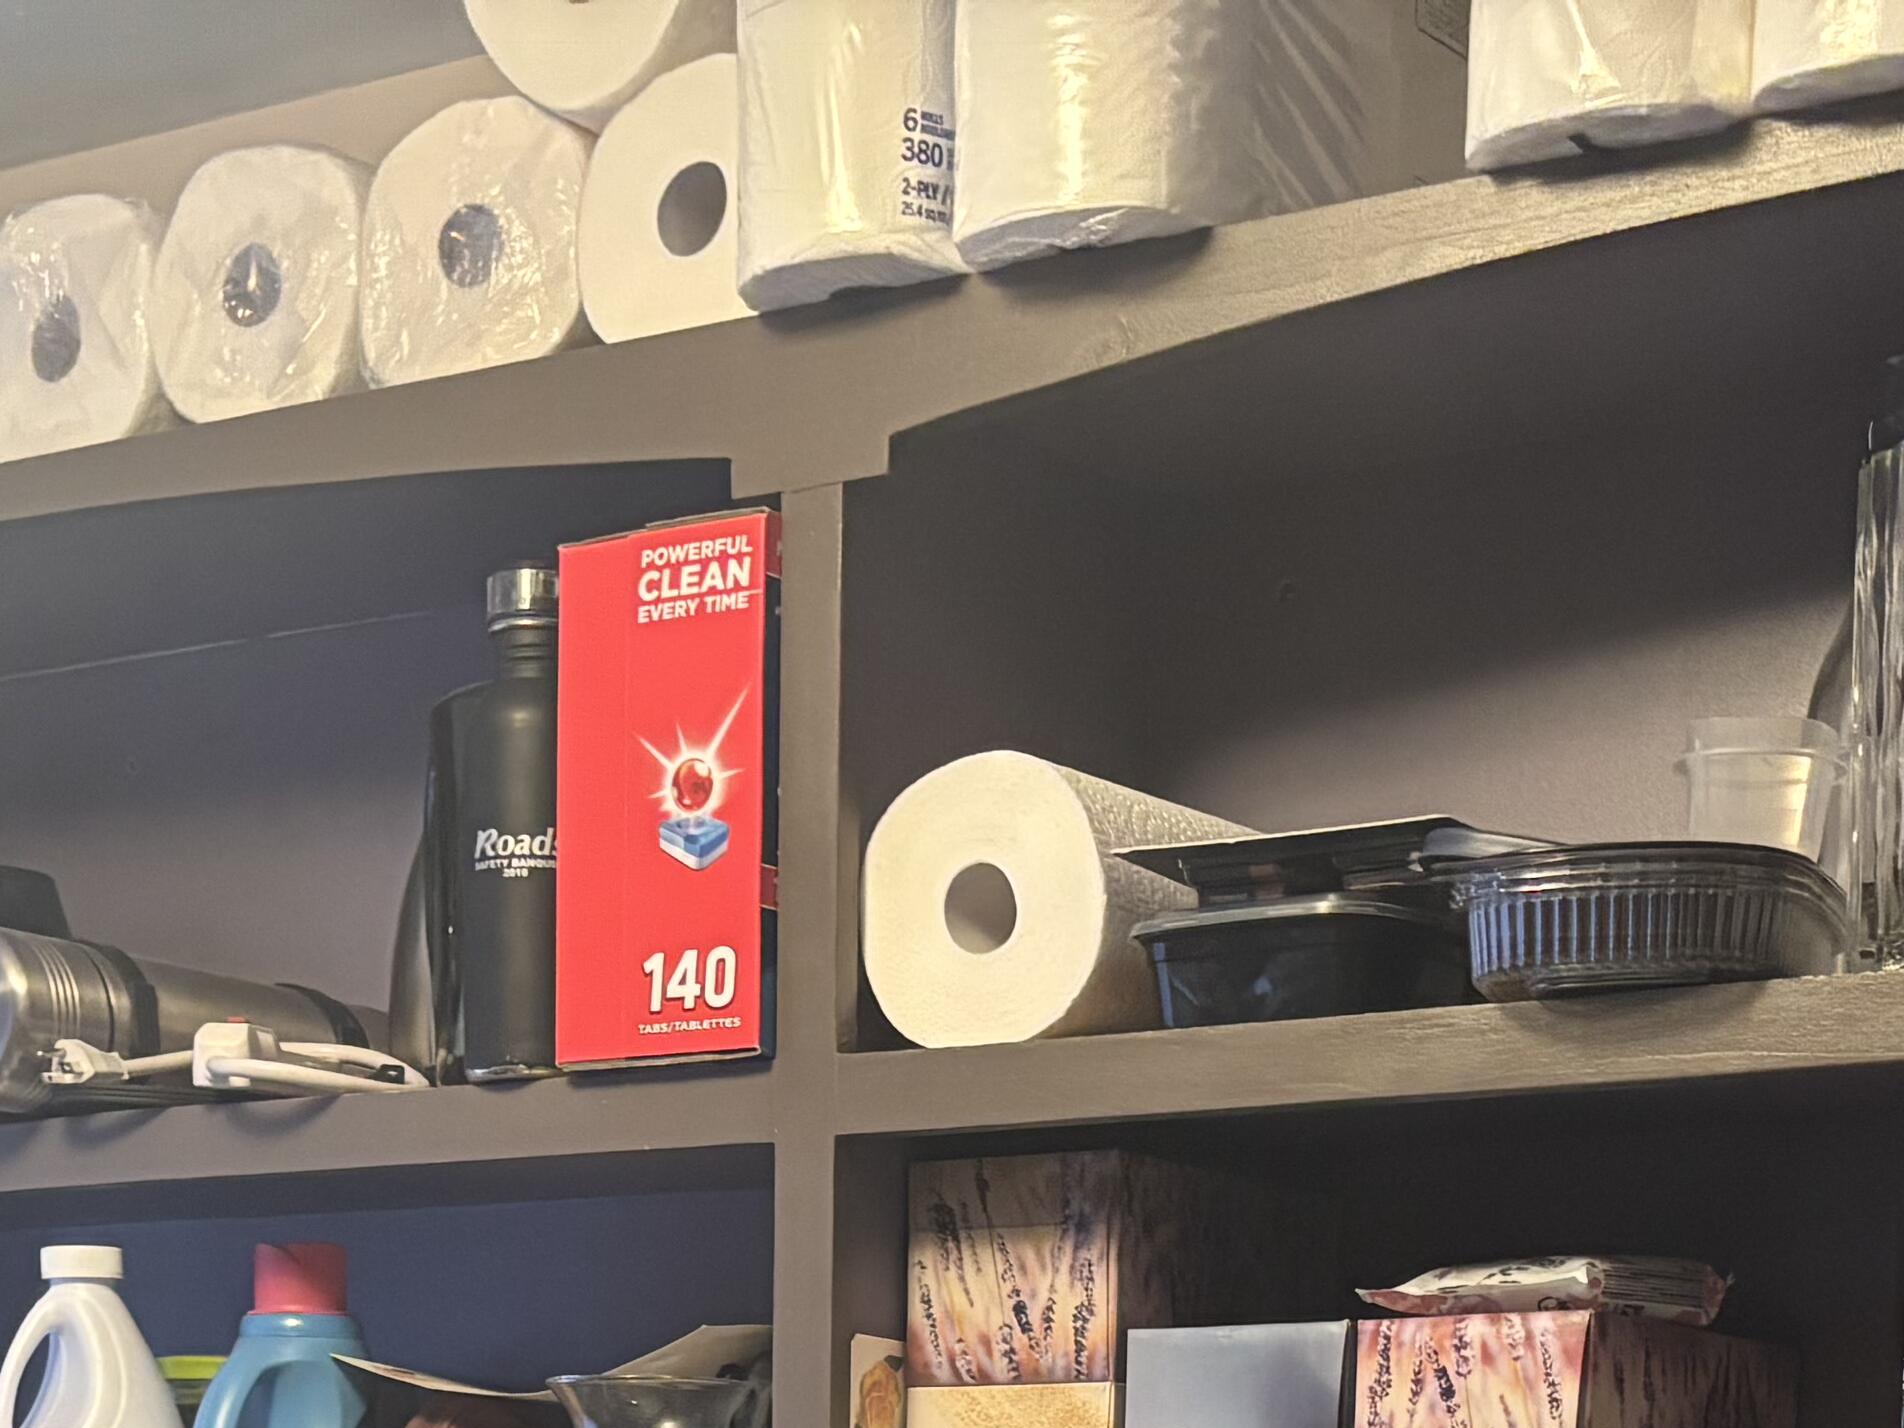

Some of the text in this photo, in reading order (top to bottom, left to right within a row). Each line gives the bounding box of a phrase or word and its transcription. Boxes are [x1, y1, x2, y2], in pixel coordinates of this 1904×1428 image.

[903, 107, 918, 132] 6
[901, 137, 943, 168] 380
[901, 177, 939, 201] 2-PLY
[641, 534, 753, 568] POWERFUL
[638, 556, 752, 601] CLEAN
[637, 591, 751, 624] EVERY TIME
[474, 827, 557, 860] Road
[642, 945, 737, 1013] 140
[638, 1017, 742, 1034] TABS/TABLETTES
